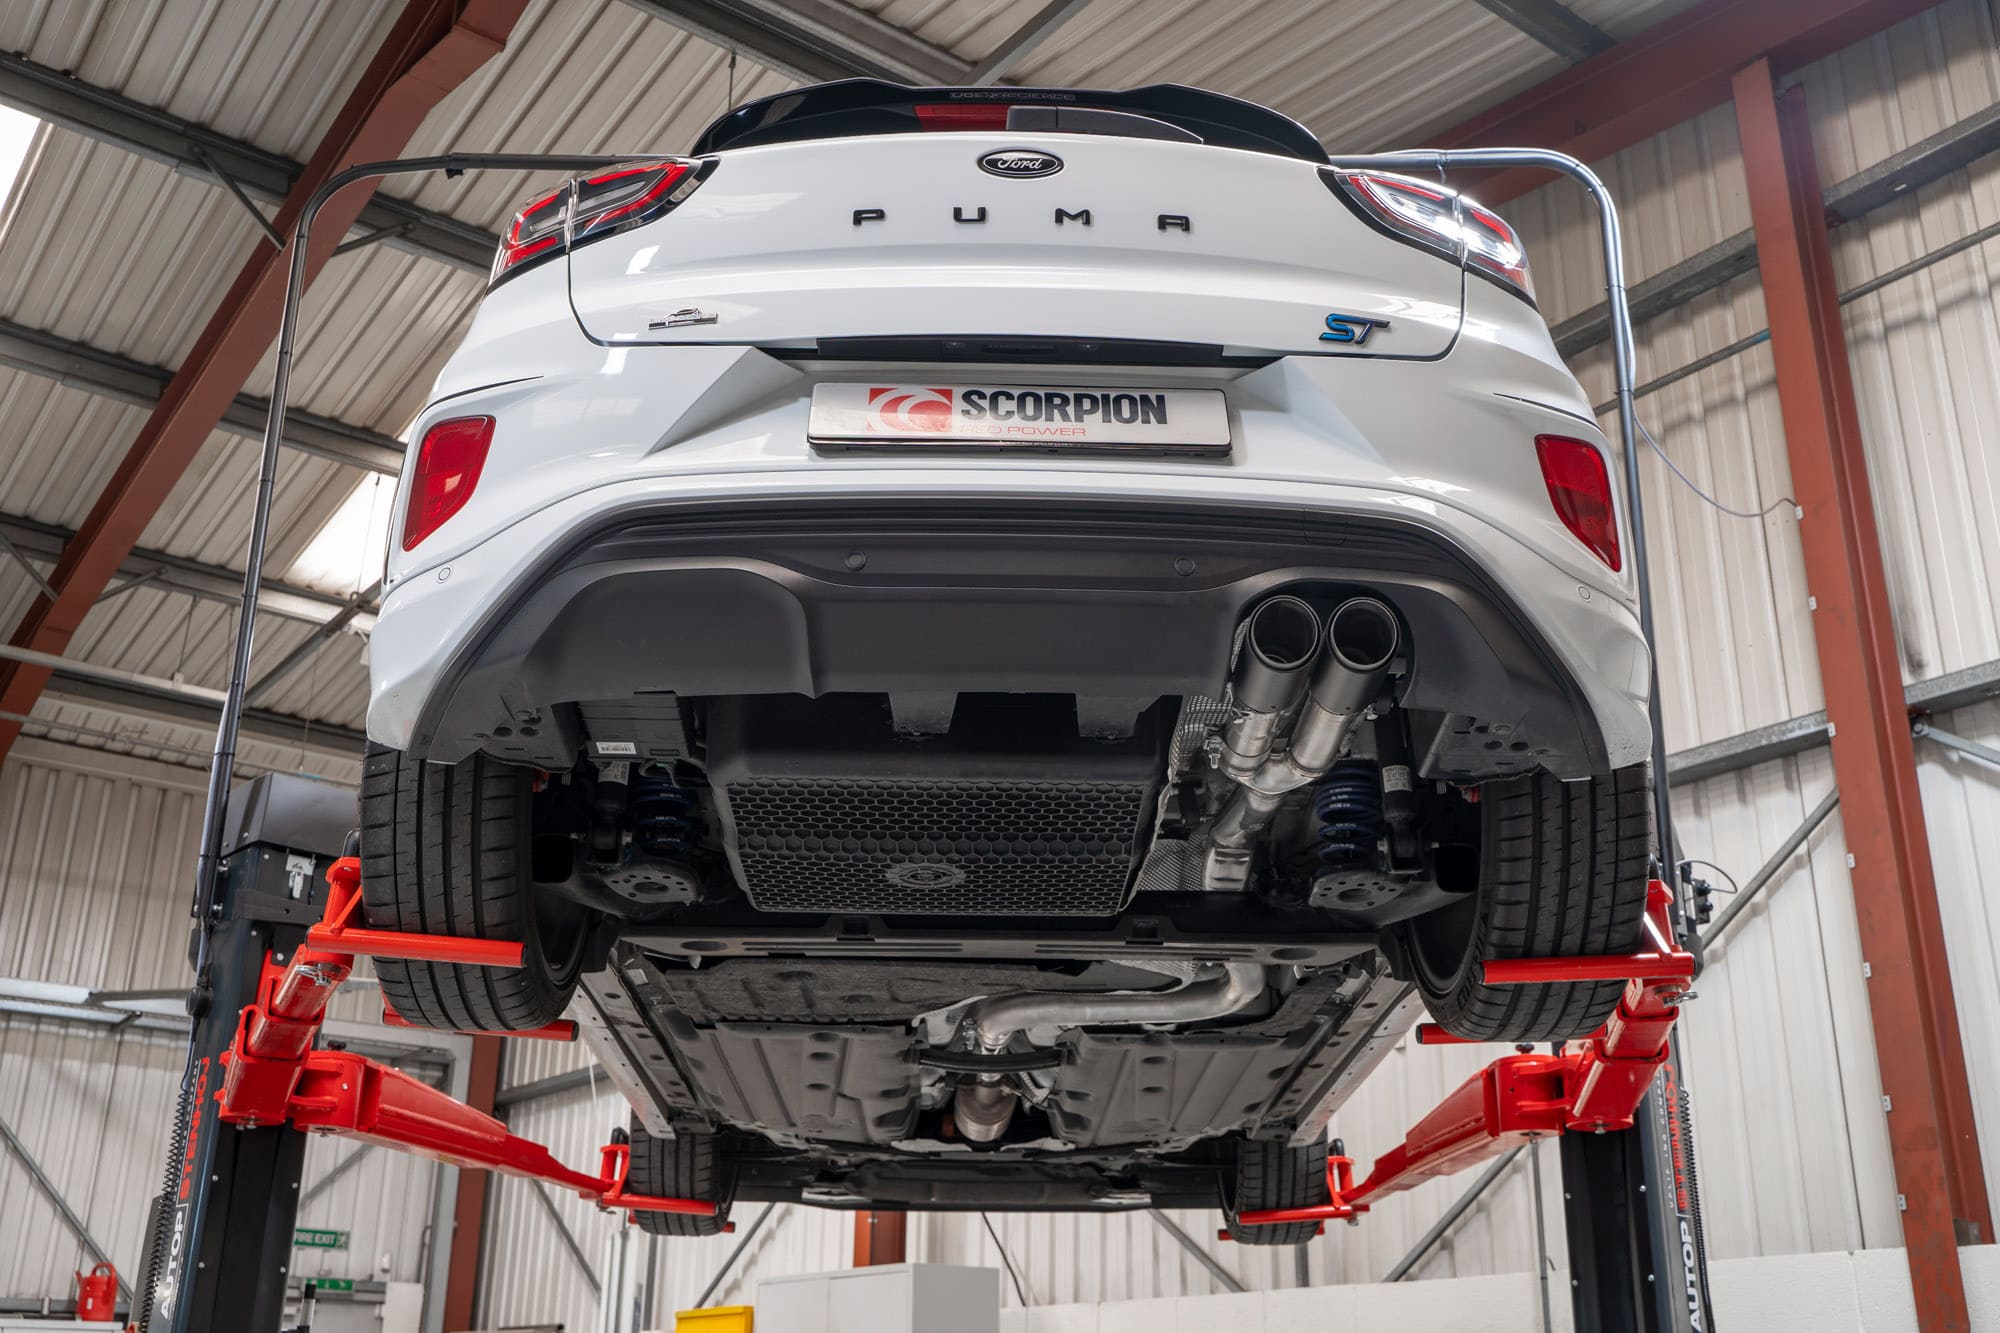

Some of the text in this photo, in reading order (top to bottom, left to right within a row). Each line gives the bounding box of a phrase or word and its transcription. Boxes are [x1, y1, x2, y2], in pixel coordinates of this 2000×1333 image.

[997, 156, 1042, 169] Ford
[853, 206, 1192, 232] PUMA
[1319, 314, 1391, 344] ST
[961, 389, 1168, 425] SCORPION
[1007, 426, 1087, 436] POWER
[161, 1210, 183, 1320] AUTOP
[1680, 1221, 1702, 1333] AUTOP
